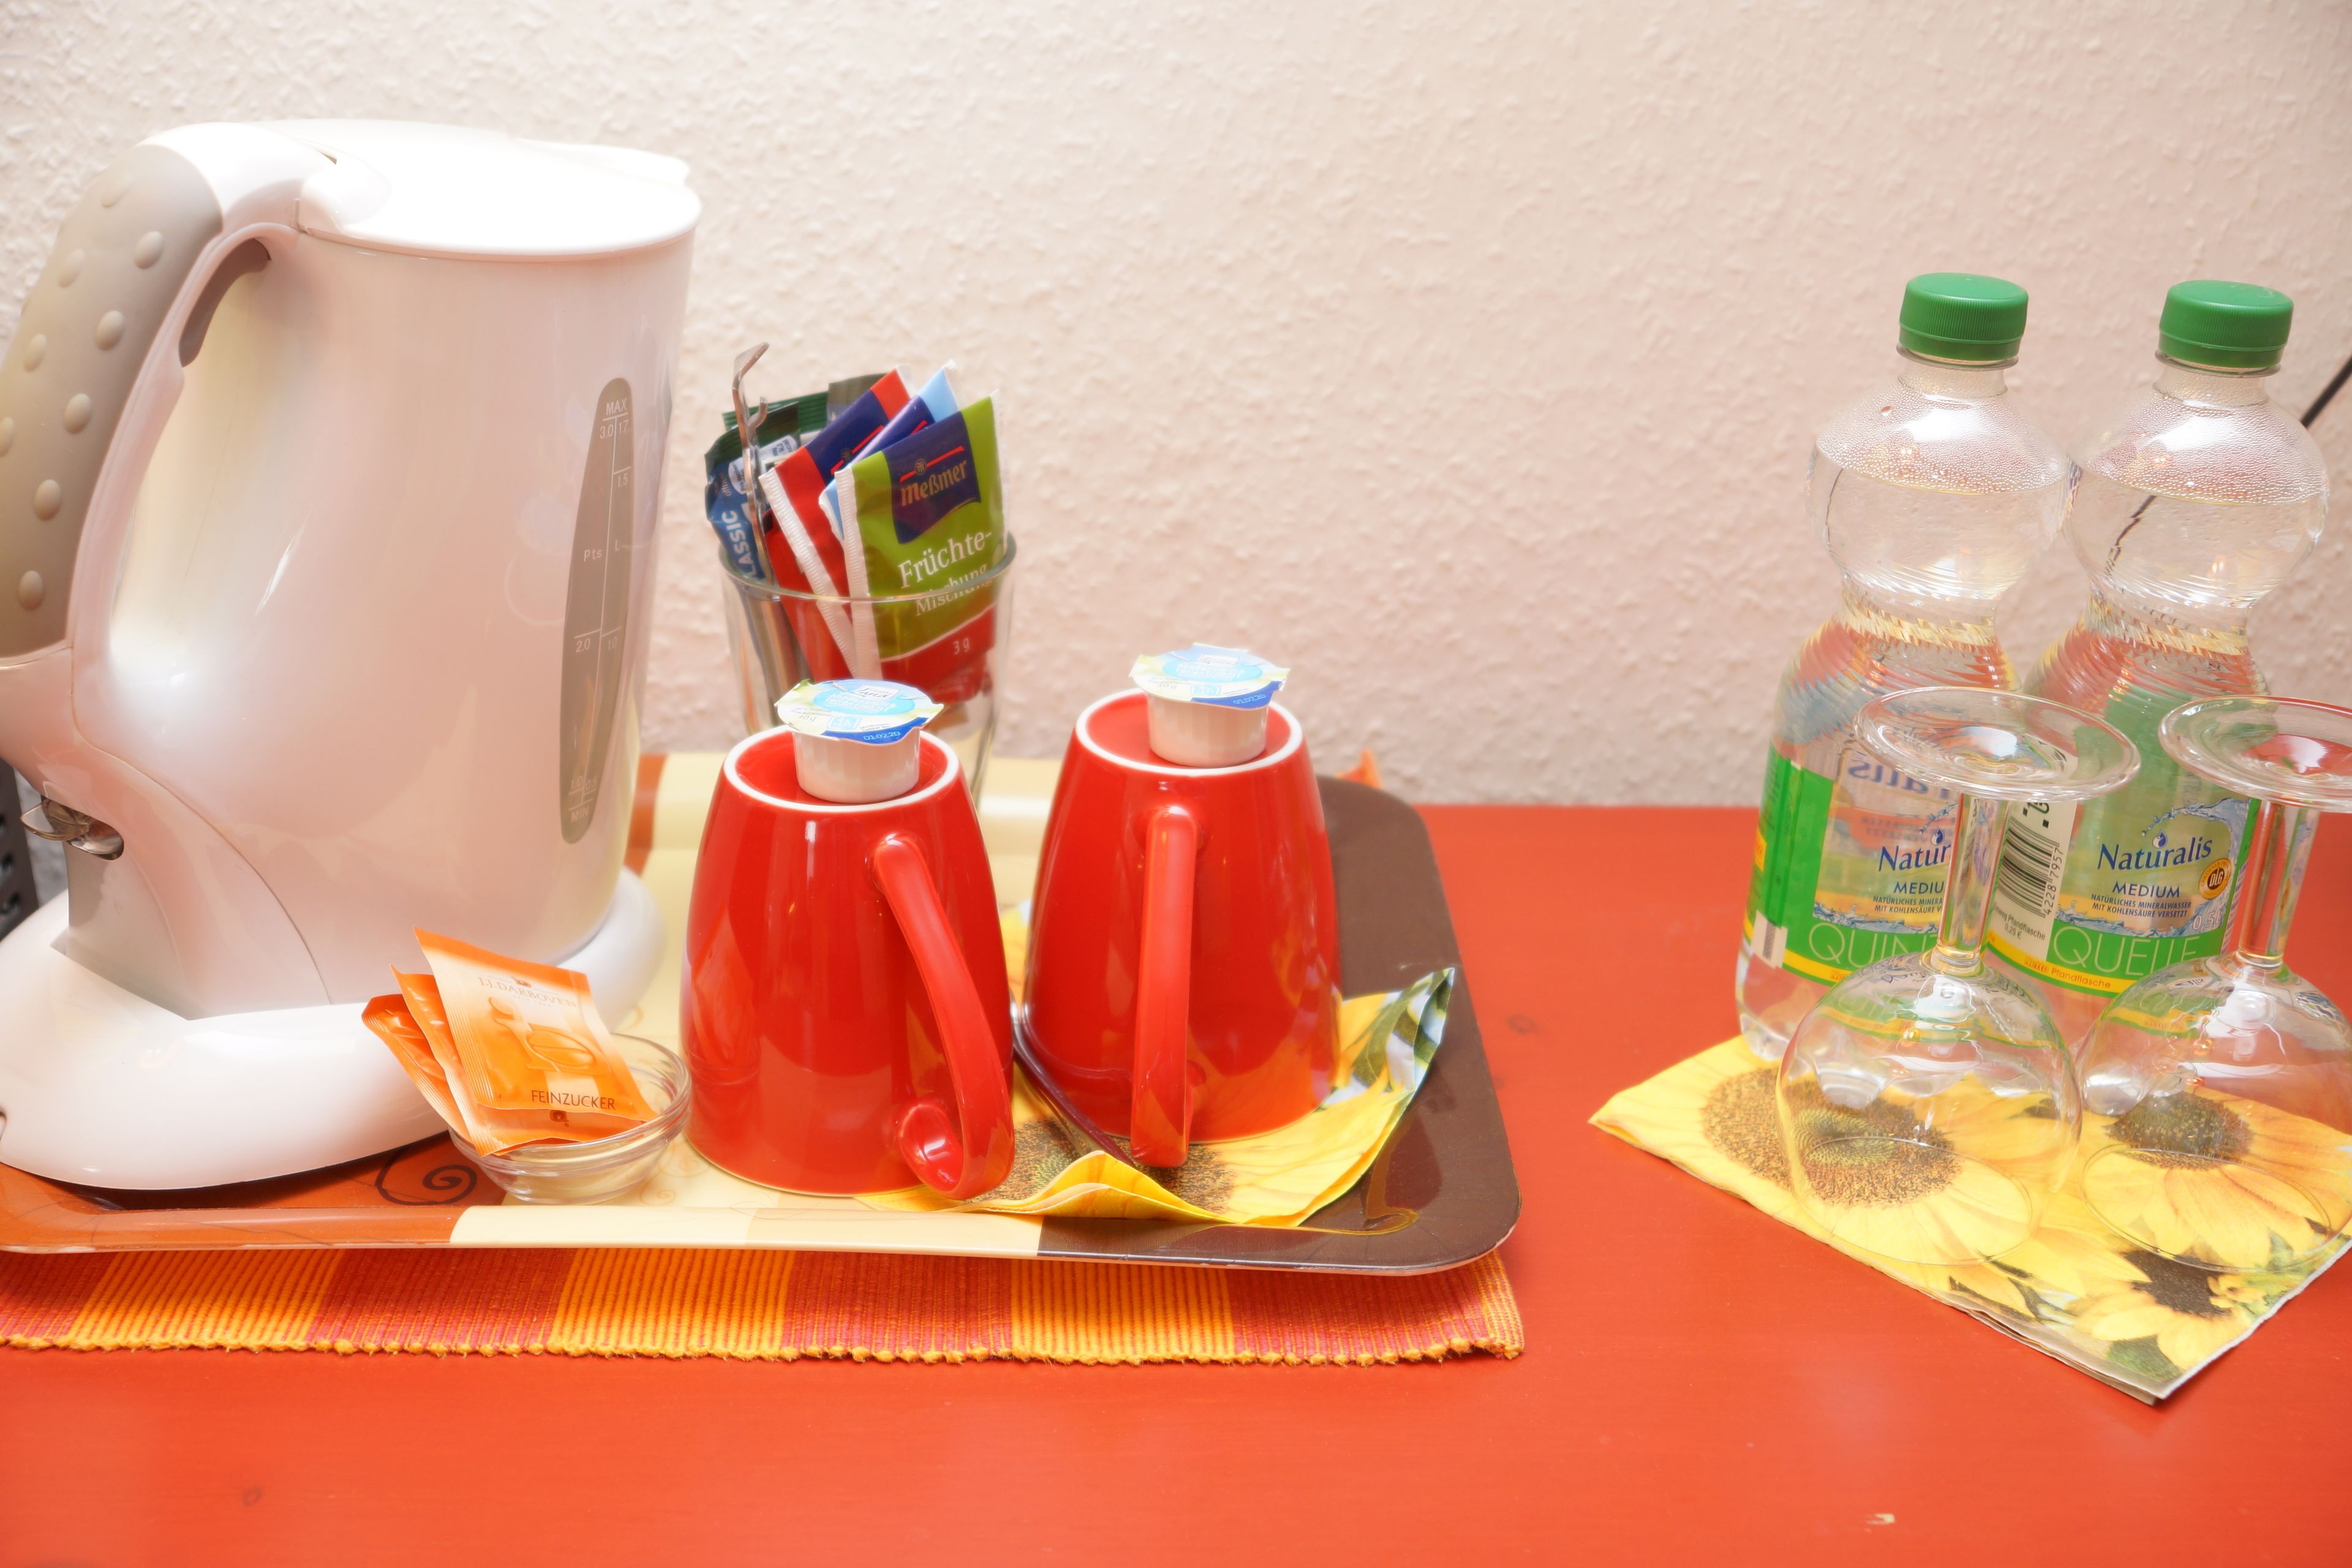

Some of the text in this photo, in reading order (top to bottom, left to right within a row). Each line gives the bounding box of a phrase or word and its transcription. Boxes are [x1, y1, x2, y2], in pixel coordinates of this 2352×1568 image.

[606, 398, 627, 415] MAX
[600, 424, 613, 439] 3.0
[618, 419, 629, 434] 1.7
[617, 473, 628, 488] 1.5
[722, 510, 756, 576] LASSIC
[898, 530, 992, 589] Früchte-
[576, 638, 590, 653] 2.0
[953, 637, 970, 655] 3 g
[1879, 844, 1951, 872] Natur
[2097, 837, 2212, 870] Naturalis
[2043, 847, 2064, 916] 4228 7957
[2209, 867, 2224, 888] DLG
[1893, 881, 1945, 894] MEDIU
[2112, 880, 2180, 898] MEDIUM
[1873, 896, 1917, 905] NATÜRLICHES
[1889, 905, 1934, 914] KOHLENSÄURE
[2091, 893, 2192, 910] NATÜRLICHES MINERALWASSER
[2092, 902, 2105, 911] MIT
[2107, 905, 2155, 918] KOHLENSÄURE
[2008, 914, 2046, 940] Pfandflasche
[2051, 968, 2111, 989] Pfandflasche
[531, 1090, 616, 1111] FEINZUCKER
